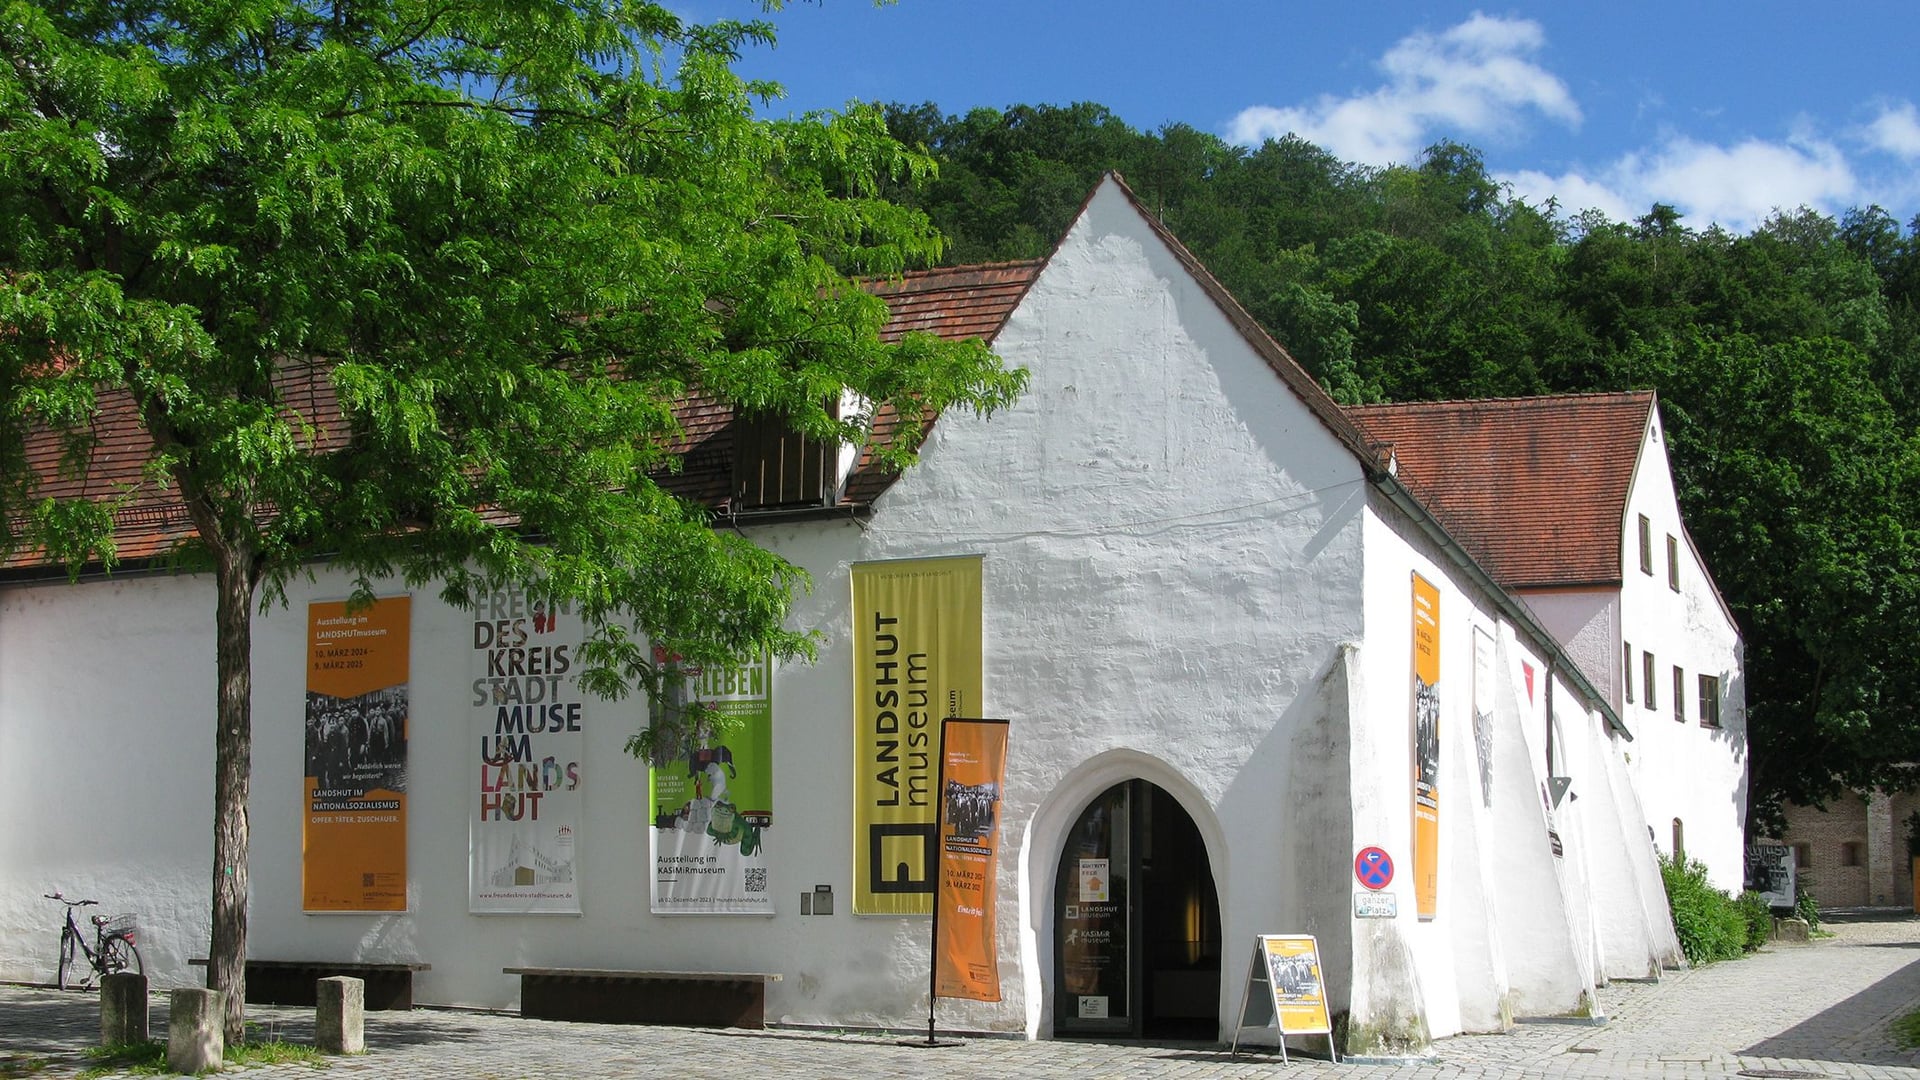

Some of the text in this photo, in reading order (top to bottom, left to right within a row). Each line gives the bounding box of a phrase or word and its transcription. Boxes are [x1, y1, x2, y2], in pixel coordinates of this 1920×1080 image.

[317, 616, 357, 625] Ausstellung
[316, 629, 387, 639] LANDSHUTmuseum
[474, 619, 528, 649] DES
[315, 650, 326, 658] 10.
[327, 648, 349, 657] MÄRZ
[323, 661, 345, 669] MÄRZ
[488, 645, 570, 677] KREIS
[472, 675, 563, 706] STADT
[875, 611, 899, 806] LANDSHUT
[495, 703, 581, 734] MUSE
[907, 653, 928, 806] museum
[482, 734, 532, 765] UM
[482, 757, 581, 792] LANDS
[313, 789, 352, 797] LANDSHUT
[313, 801, 399, 810] NATIONALSOZIALISMUS
[481, 792, 543, 821] HUT
[657, 855, 705, 864] Ausstellung
[657, 866, 726, 874] KASiMiRmuseum
[956, 870, 973, 879] MÄRZ
[953, 881, 971, 890] MÄRZ
